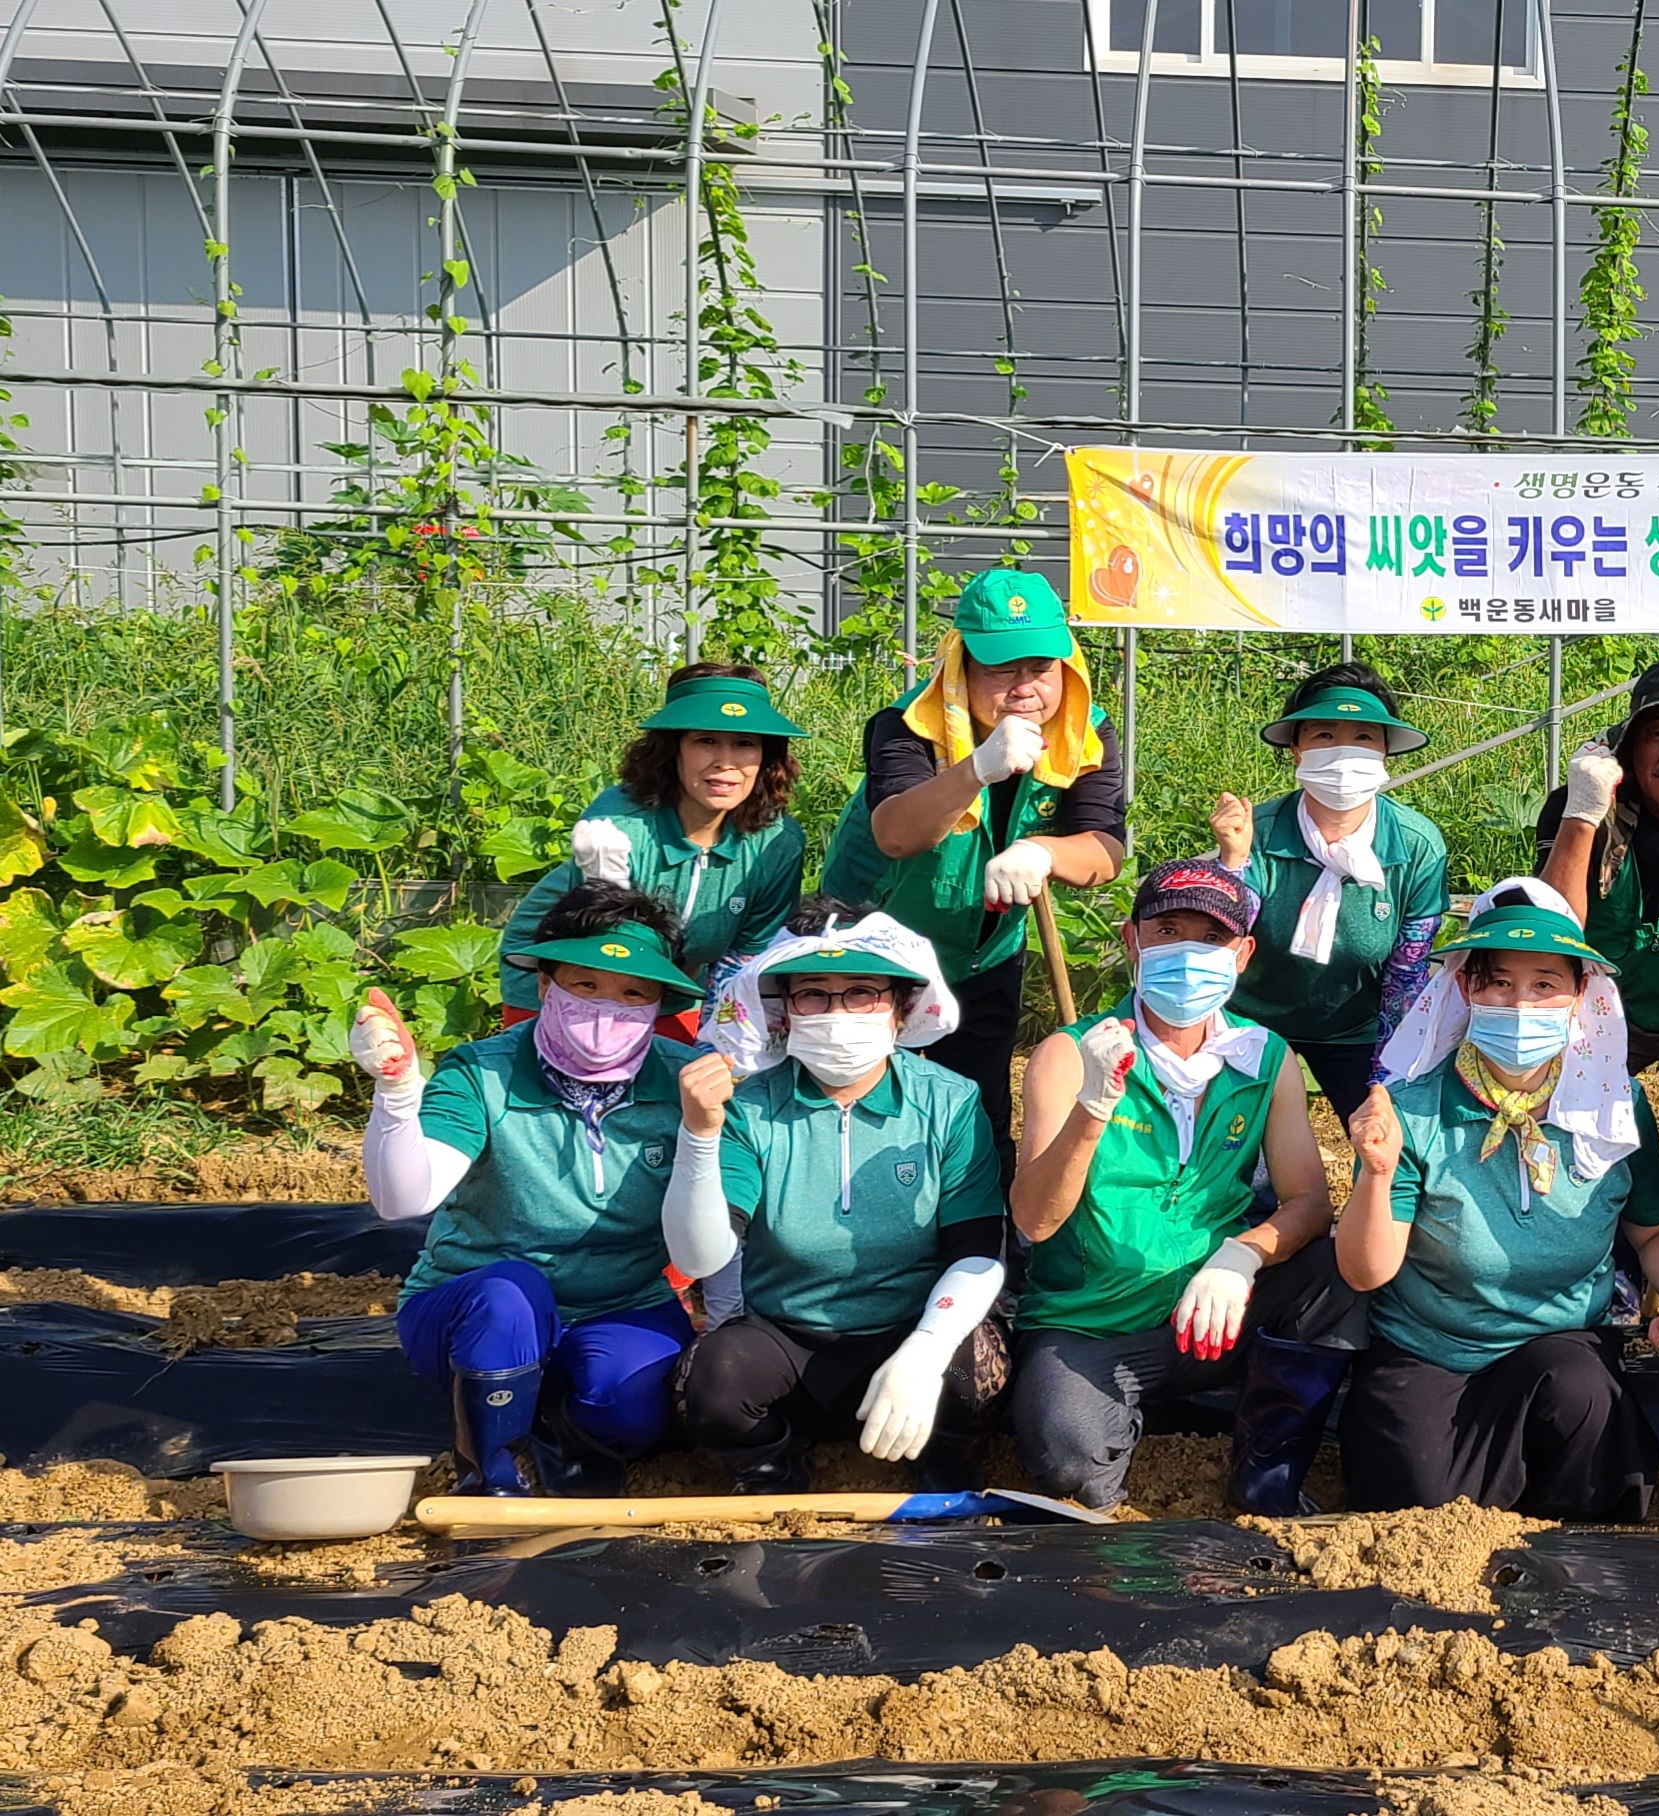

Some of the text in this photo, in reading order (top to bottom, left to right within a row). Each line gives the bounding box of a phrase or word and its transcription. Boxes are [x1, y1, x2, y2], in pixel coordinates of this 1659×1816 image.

[1513, 471, 1645, 499] 생명운동
[1224, 512, 1347, 576] 희망의
[1365, 514, 1489, 577] 씨앗을
[1507, 514, 1628, 578] 키우는
[1457, 597, 1616, 623] 백운동새마을
